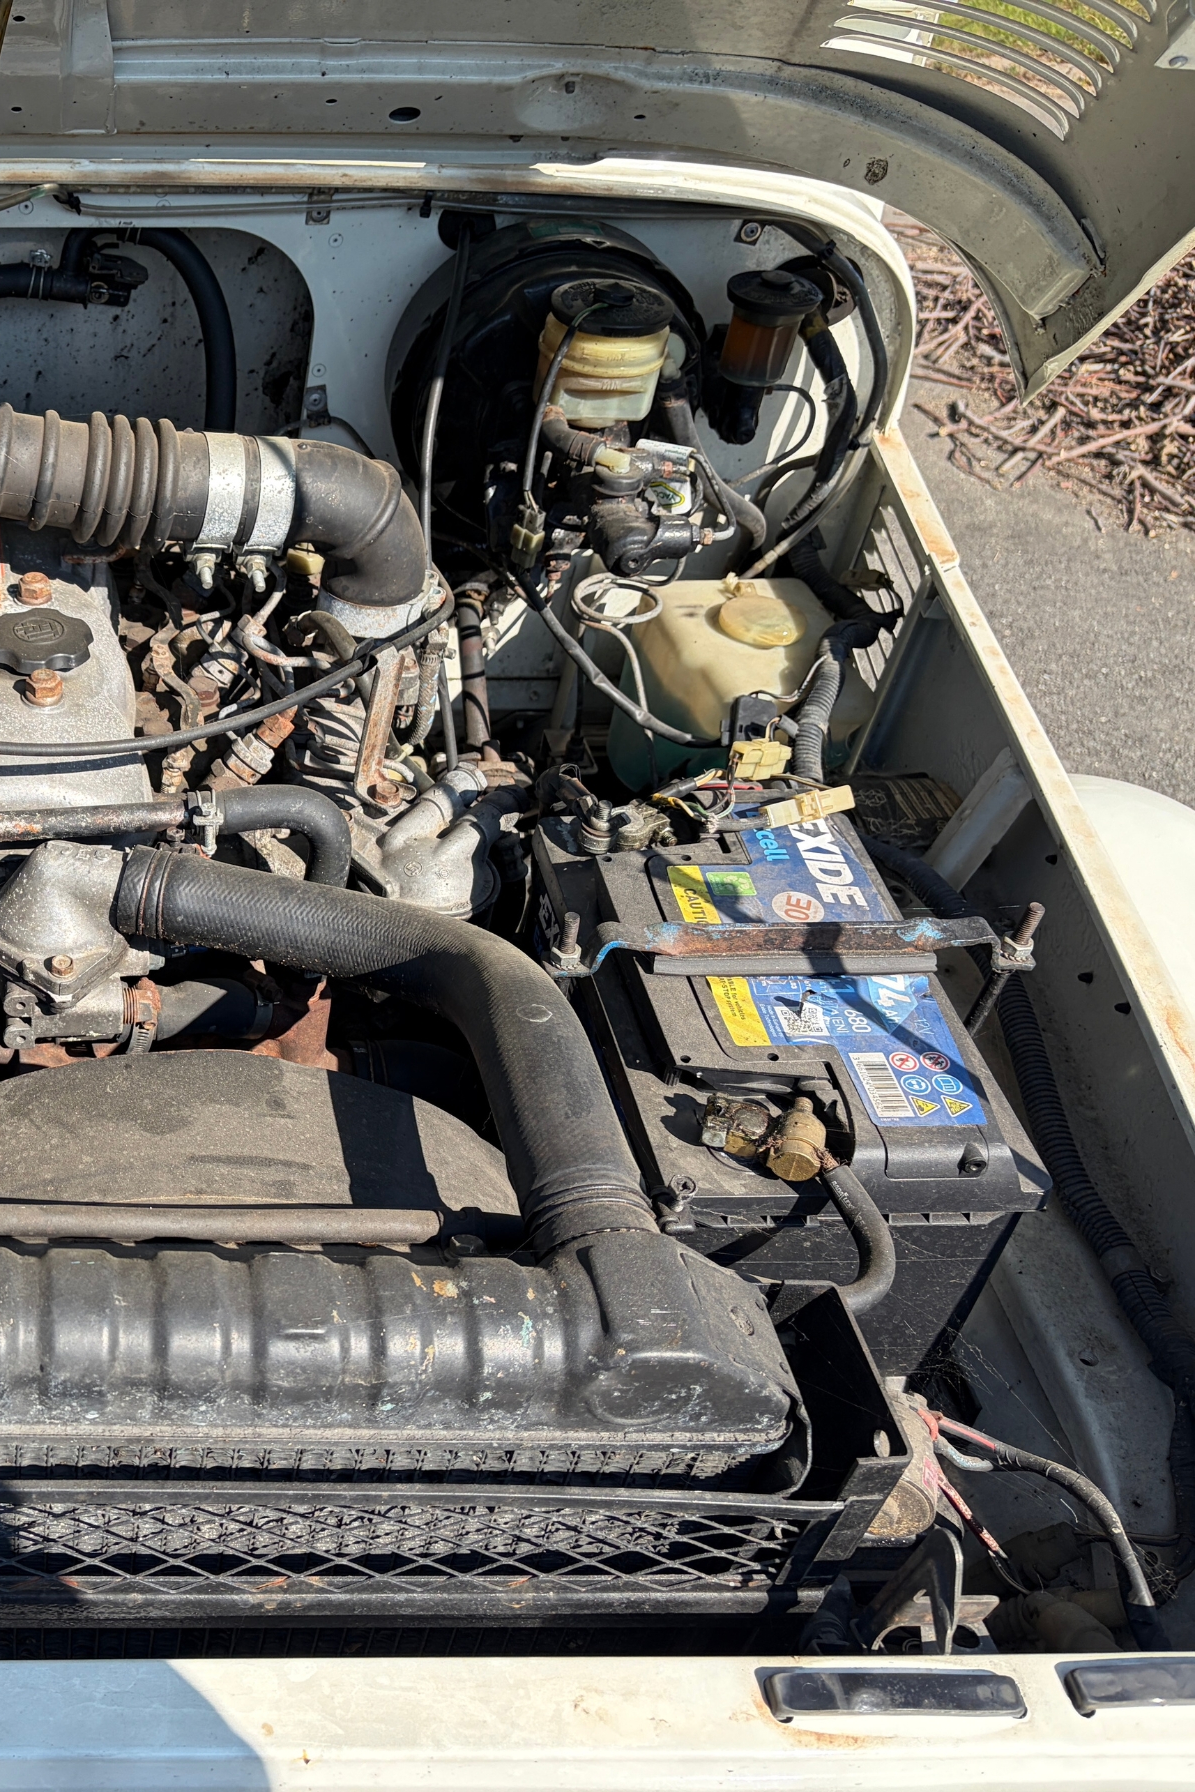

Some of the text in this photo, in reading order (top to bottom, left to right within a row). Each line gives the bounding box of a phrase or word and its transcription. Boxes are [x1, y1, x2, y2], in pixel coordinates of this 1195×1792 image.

[788, 818, 868, 906] EXIDE
[725, 1000, 737, 1016] system
[871, 976, 907, 1024] 74 Ah
[735, 1001, 746, 1020] vehicles
[844, 1011, 872, 1033] 680
[914, 1018, 934, 1034] 12V
